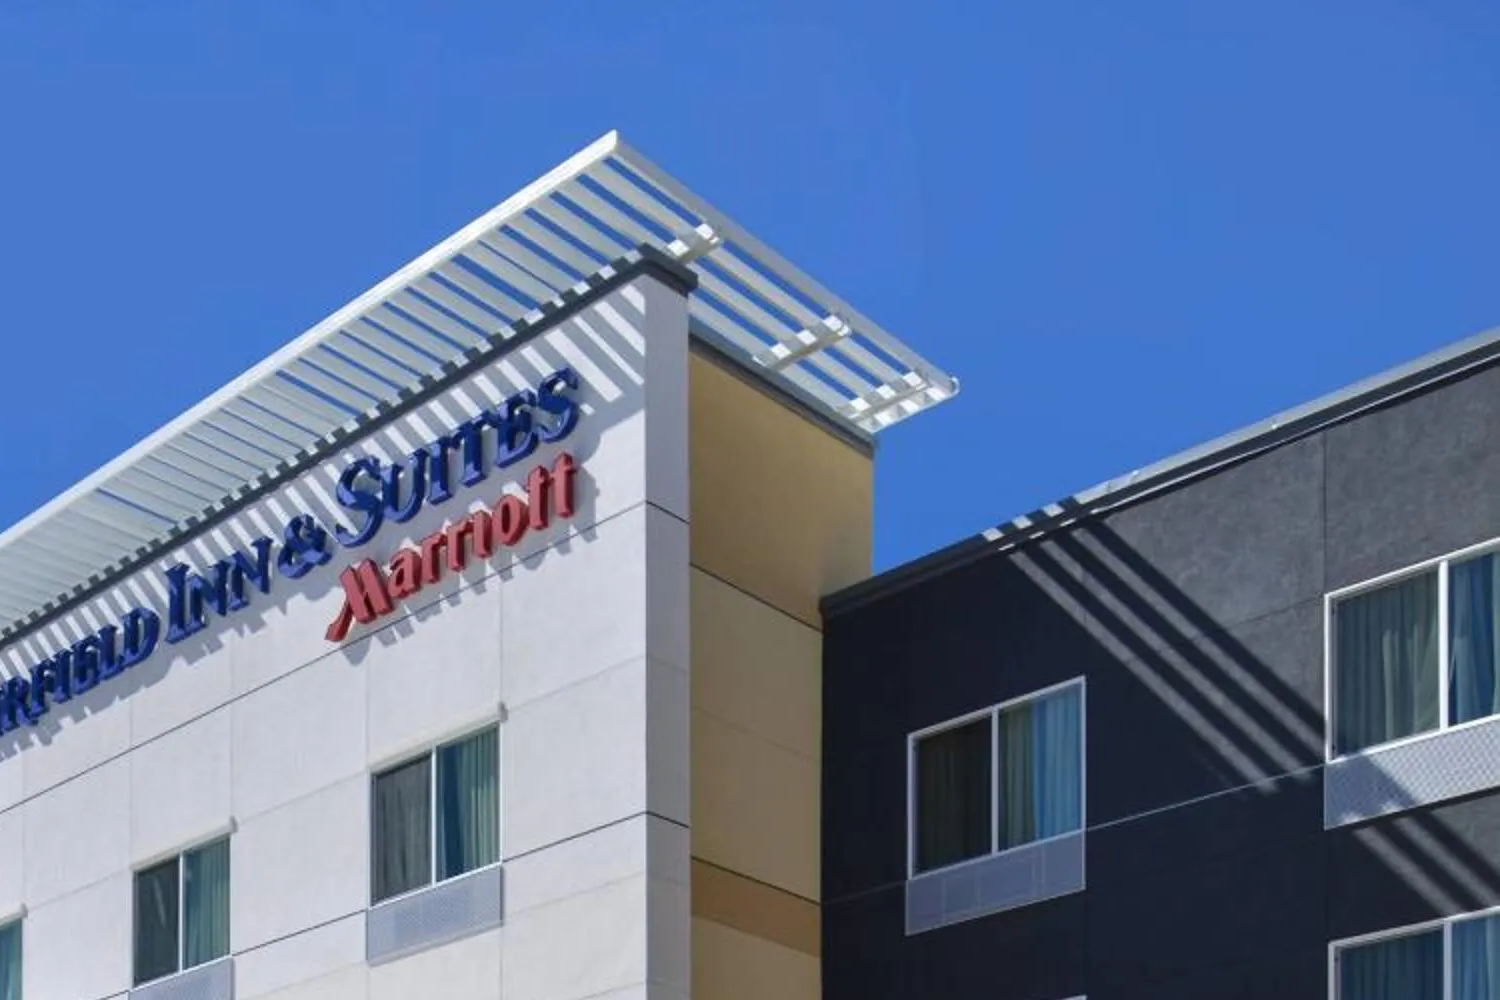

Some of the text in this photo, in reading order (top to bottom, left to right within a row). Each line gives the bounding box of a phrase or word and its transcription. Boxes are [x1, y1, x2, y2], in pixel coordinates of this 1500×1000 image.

[166, 536, 273, 644] INN
[277, 513, 333, 578] &
[335, 367, 581, 548] SUITES
[325, 451, 579, 643] Marriott
